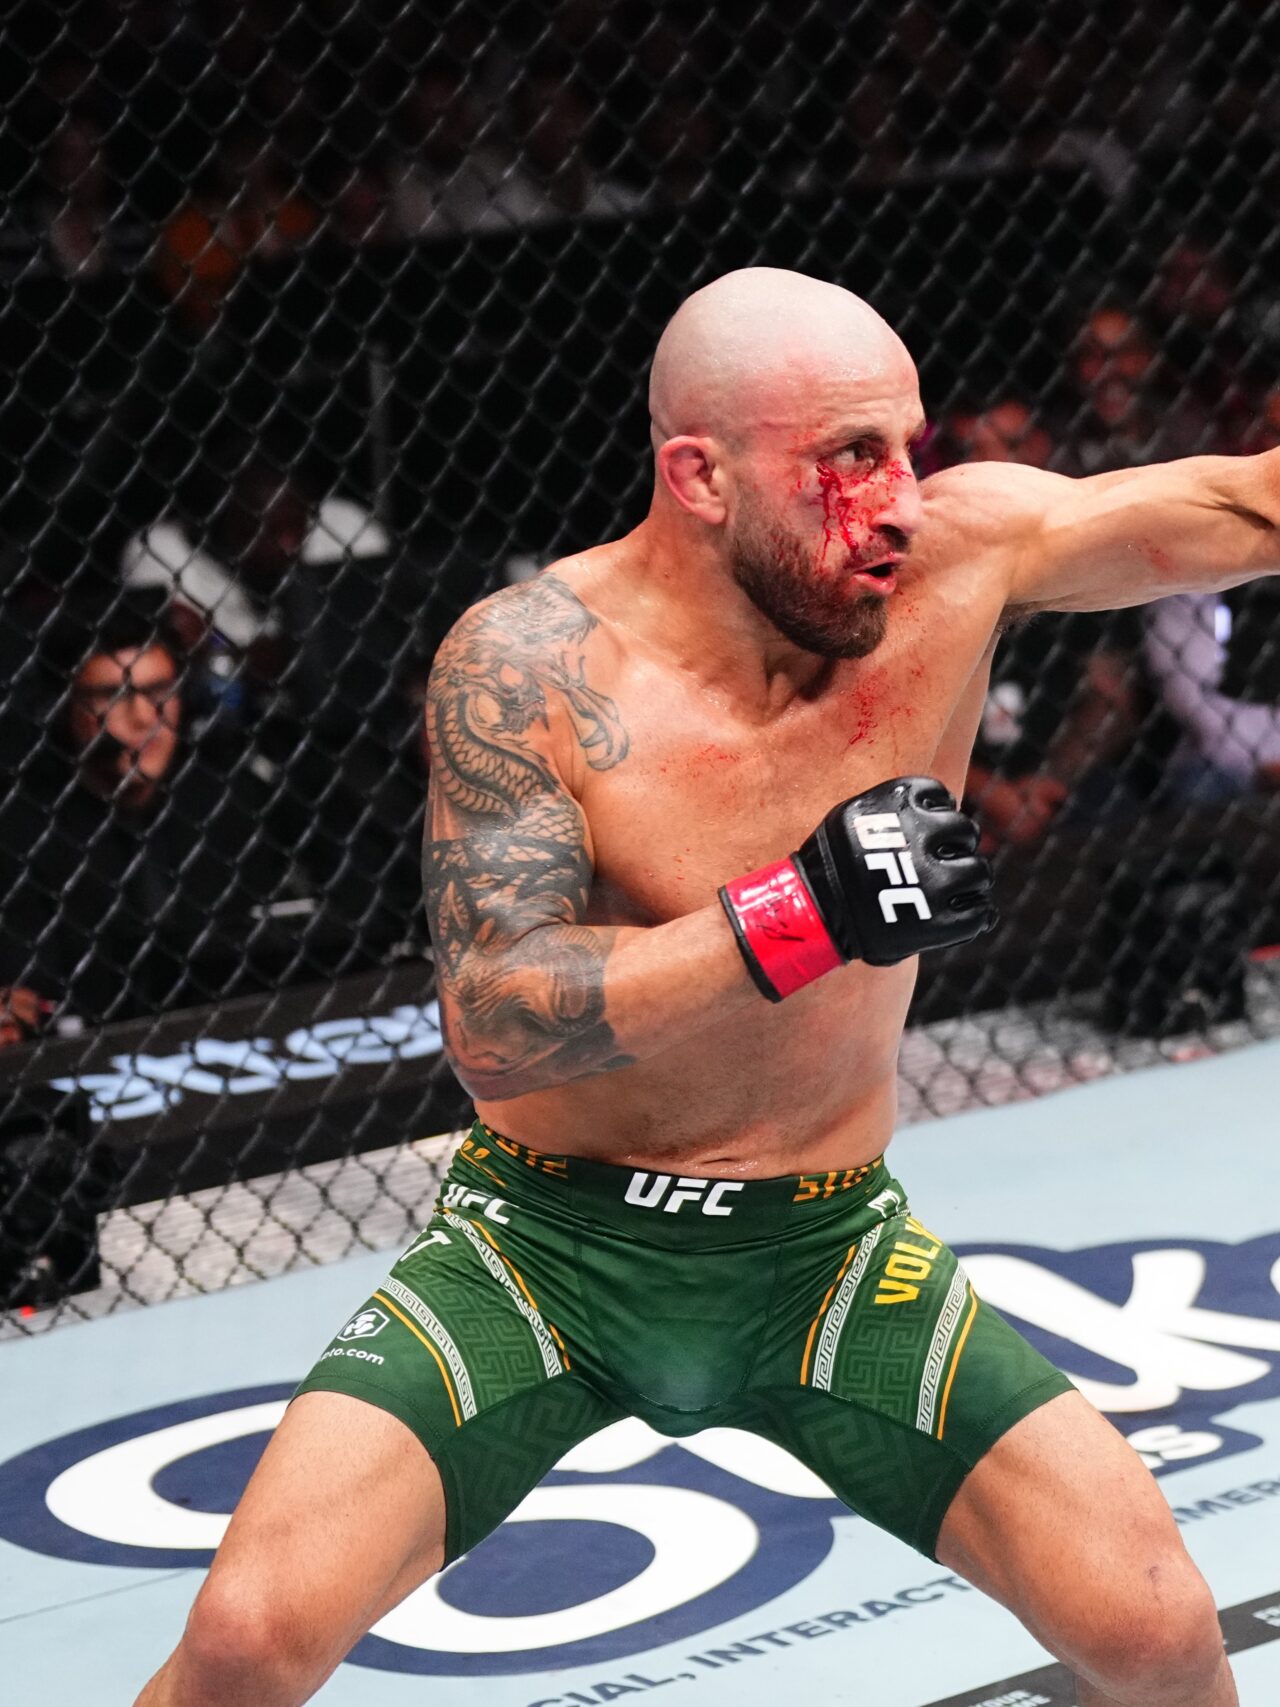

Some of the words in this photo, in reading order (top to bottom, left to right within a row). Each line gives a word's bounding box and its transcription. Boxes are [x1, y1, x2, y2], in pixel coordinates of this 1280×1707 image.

[853, 812, 932, 923] UFC
[443, 1183, 519, 1225] UFC
[624, 1172, 744, 1216] UFC
